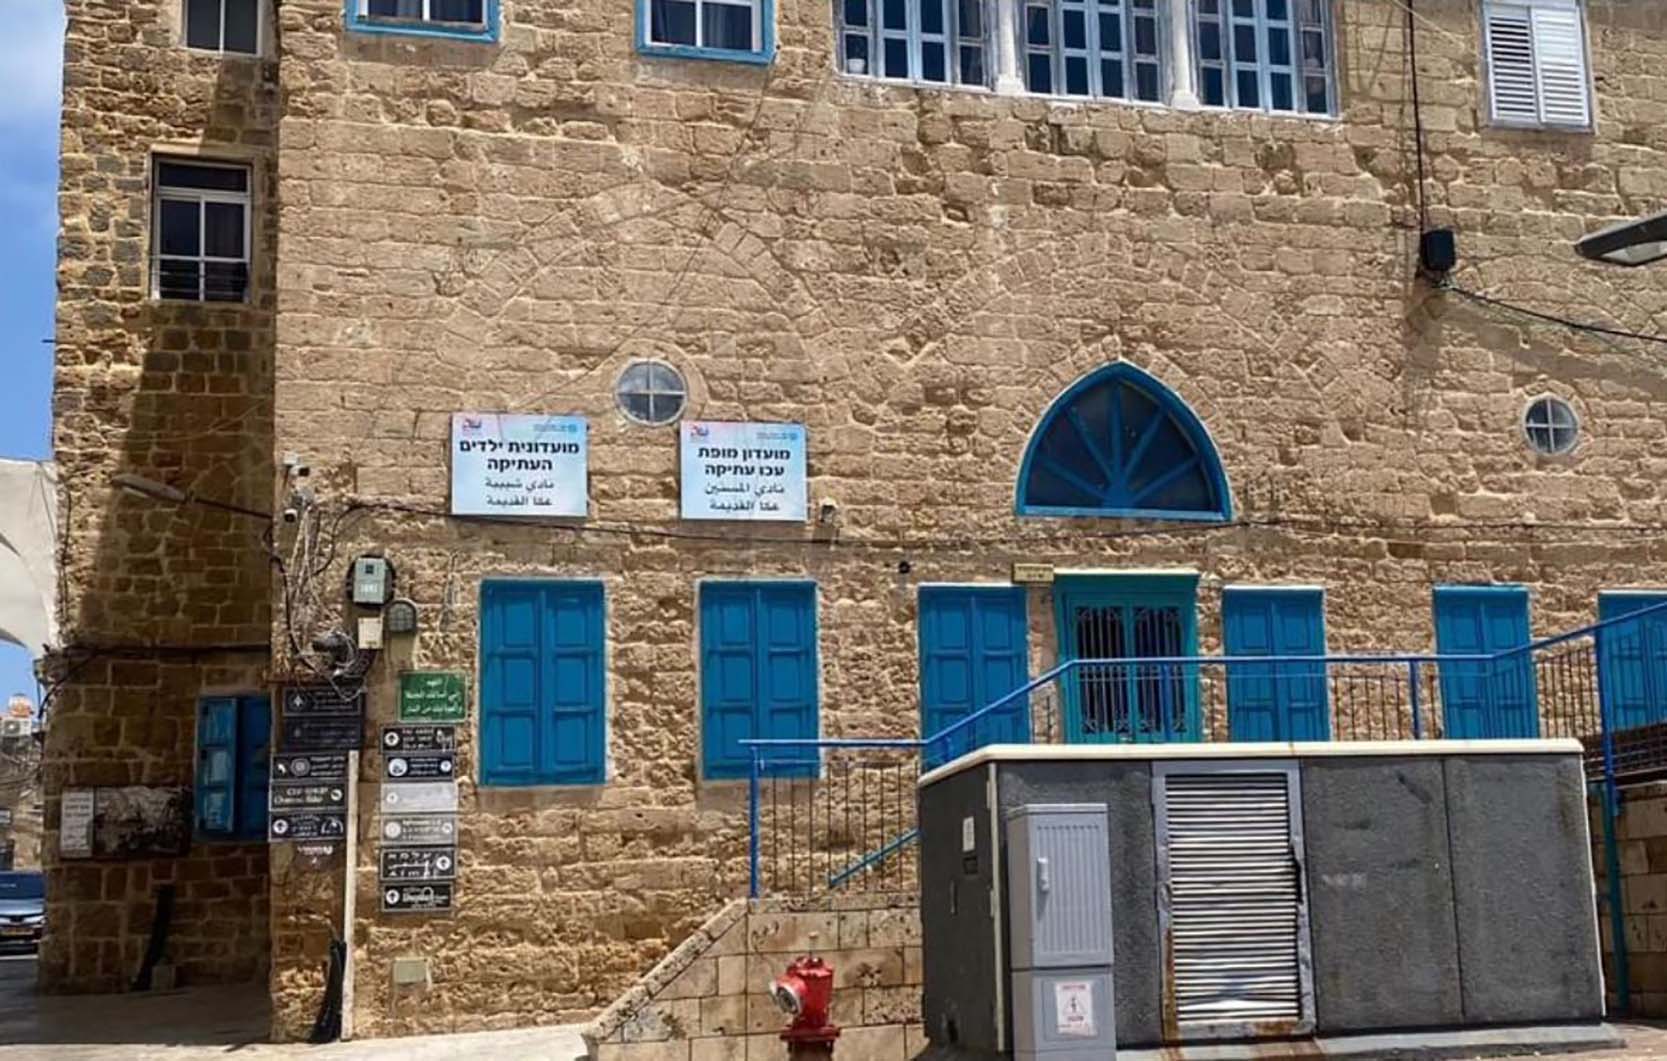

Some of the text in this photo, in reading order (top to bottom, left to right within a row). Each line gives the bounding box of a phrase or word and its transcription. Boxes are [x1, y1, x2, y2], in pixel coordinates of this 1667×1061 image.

[459, 438, 580, 454] מועדונית ילדים
[697, 447, 791, 462] מועדון מופת
[487, 458, 553, 473] העתיקה
[704, 464, 785, 478] עכו עתיקה
[525, 479, 555, 492] نادي
[753, 483, 785, 497] نادي
[486, 495, 529, 508] القديمة
[709, 499, 755, 512] القديمة
